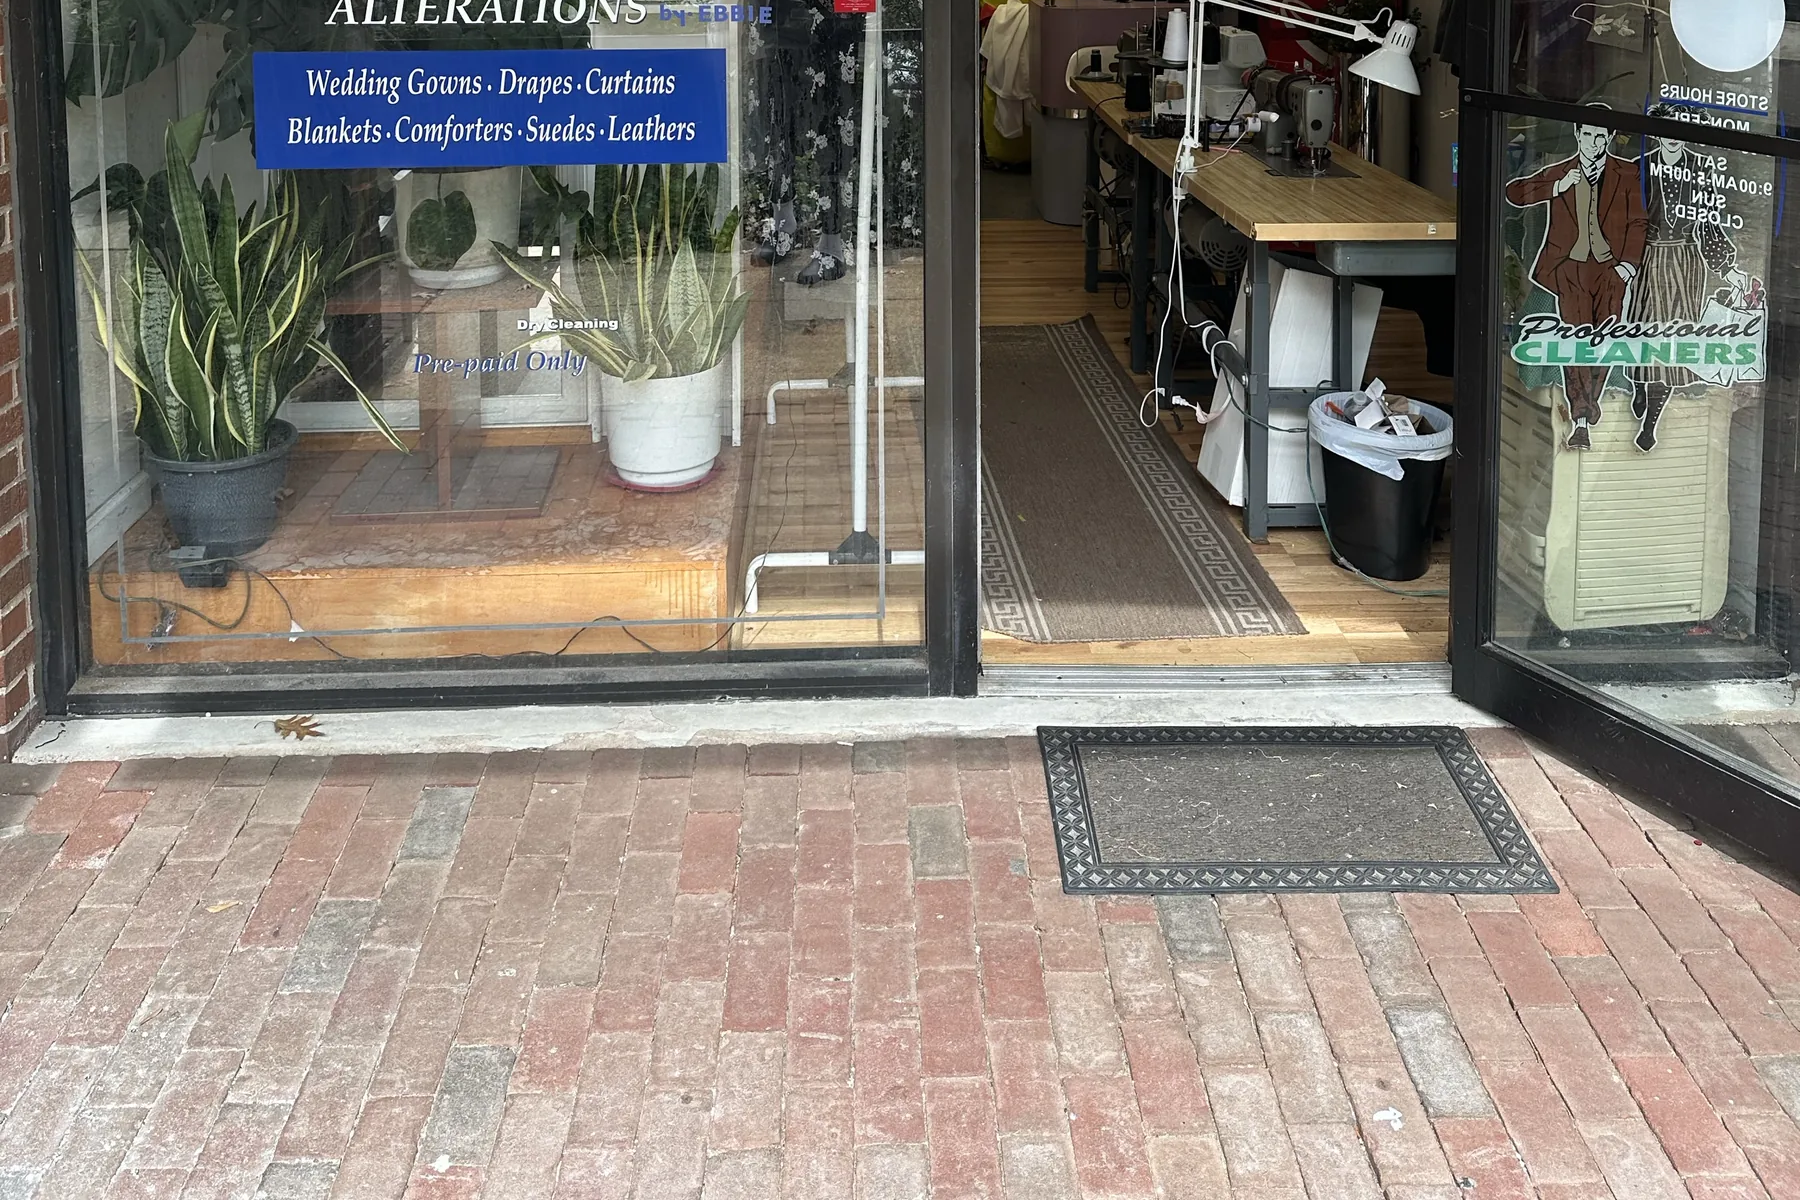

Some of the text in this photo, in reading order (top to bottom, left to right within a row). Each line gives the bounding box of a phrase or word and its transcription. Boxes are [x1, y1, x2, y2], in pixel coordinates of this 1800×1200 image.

[698, 5, 773, 23] EBBIE
[306, 67, 675, 104] Wedding Gowns Drapes Curtains
[287, 114, 696, 151] Blankets Comforters Suedes Leathers
[517, 319, 618, 332] Dry Cleaning
[1521, 314, 1760, 346] Professional
[413, 350, 587, 379] Pre-paid Only
[1515, 341, 1757, 365] CLEANERS
